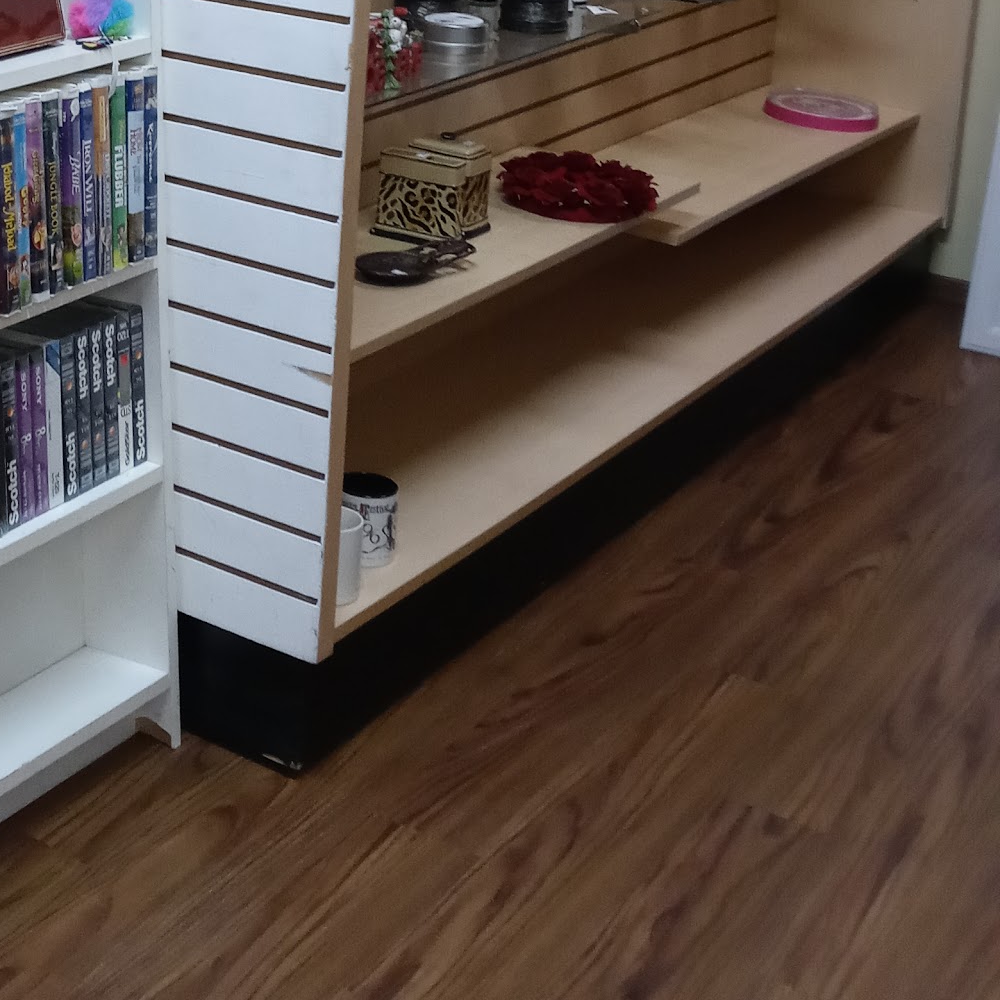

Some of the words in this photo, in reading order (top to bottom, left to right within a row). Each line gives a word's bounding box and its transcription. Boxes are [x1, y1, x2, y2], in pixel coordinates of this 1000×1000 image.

[47, 161, 57, 203] JUNGLE
[69, 155, 81, 196] BABE
[82, 139, 92, 174] IRON
[114, 145, 127, 208] FLUBBER
[50, 205, 60, 237] BOOK
[84, 173, 93, 217] WILL
[77, 334, 90, 400] Scotch
[91, 329, 103, 394] Scotch
[104, 323, 116, 387] Scotch
[20, 371, 28, 412] SONY
[35, 366, 43, 405] SONY
[136, 398, 147, 461] Scotch
[66, 430, 78, 496] Scotch
[7, 458, 20, 525] Scotch
